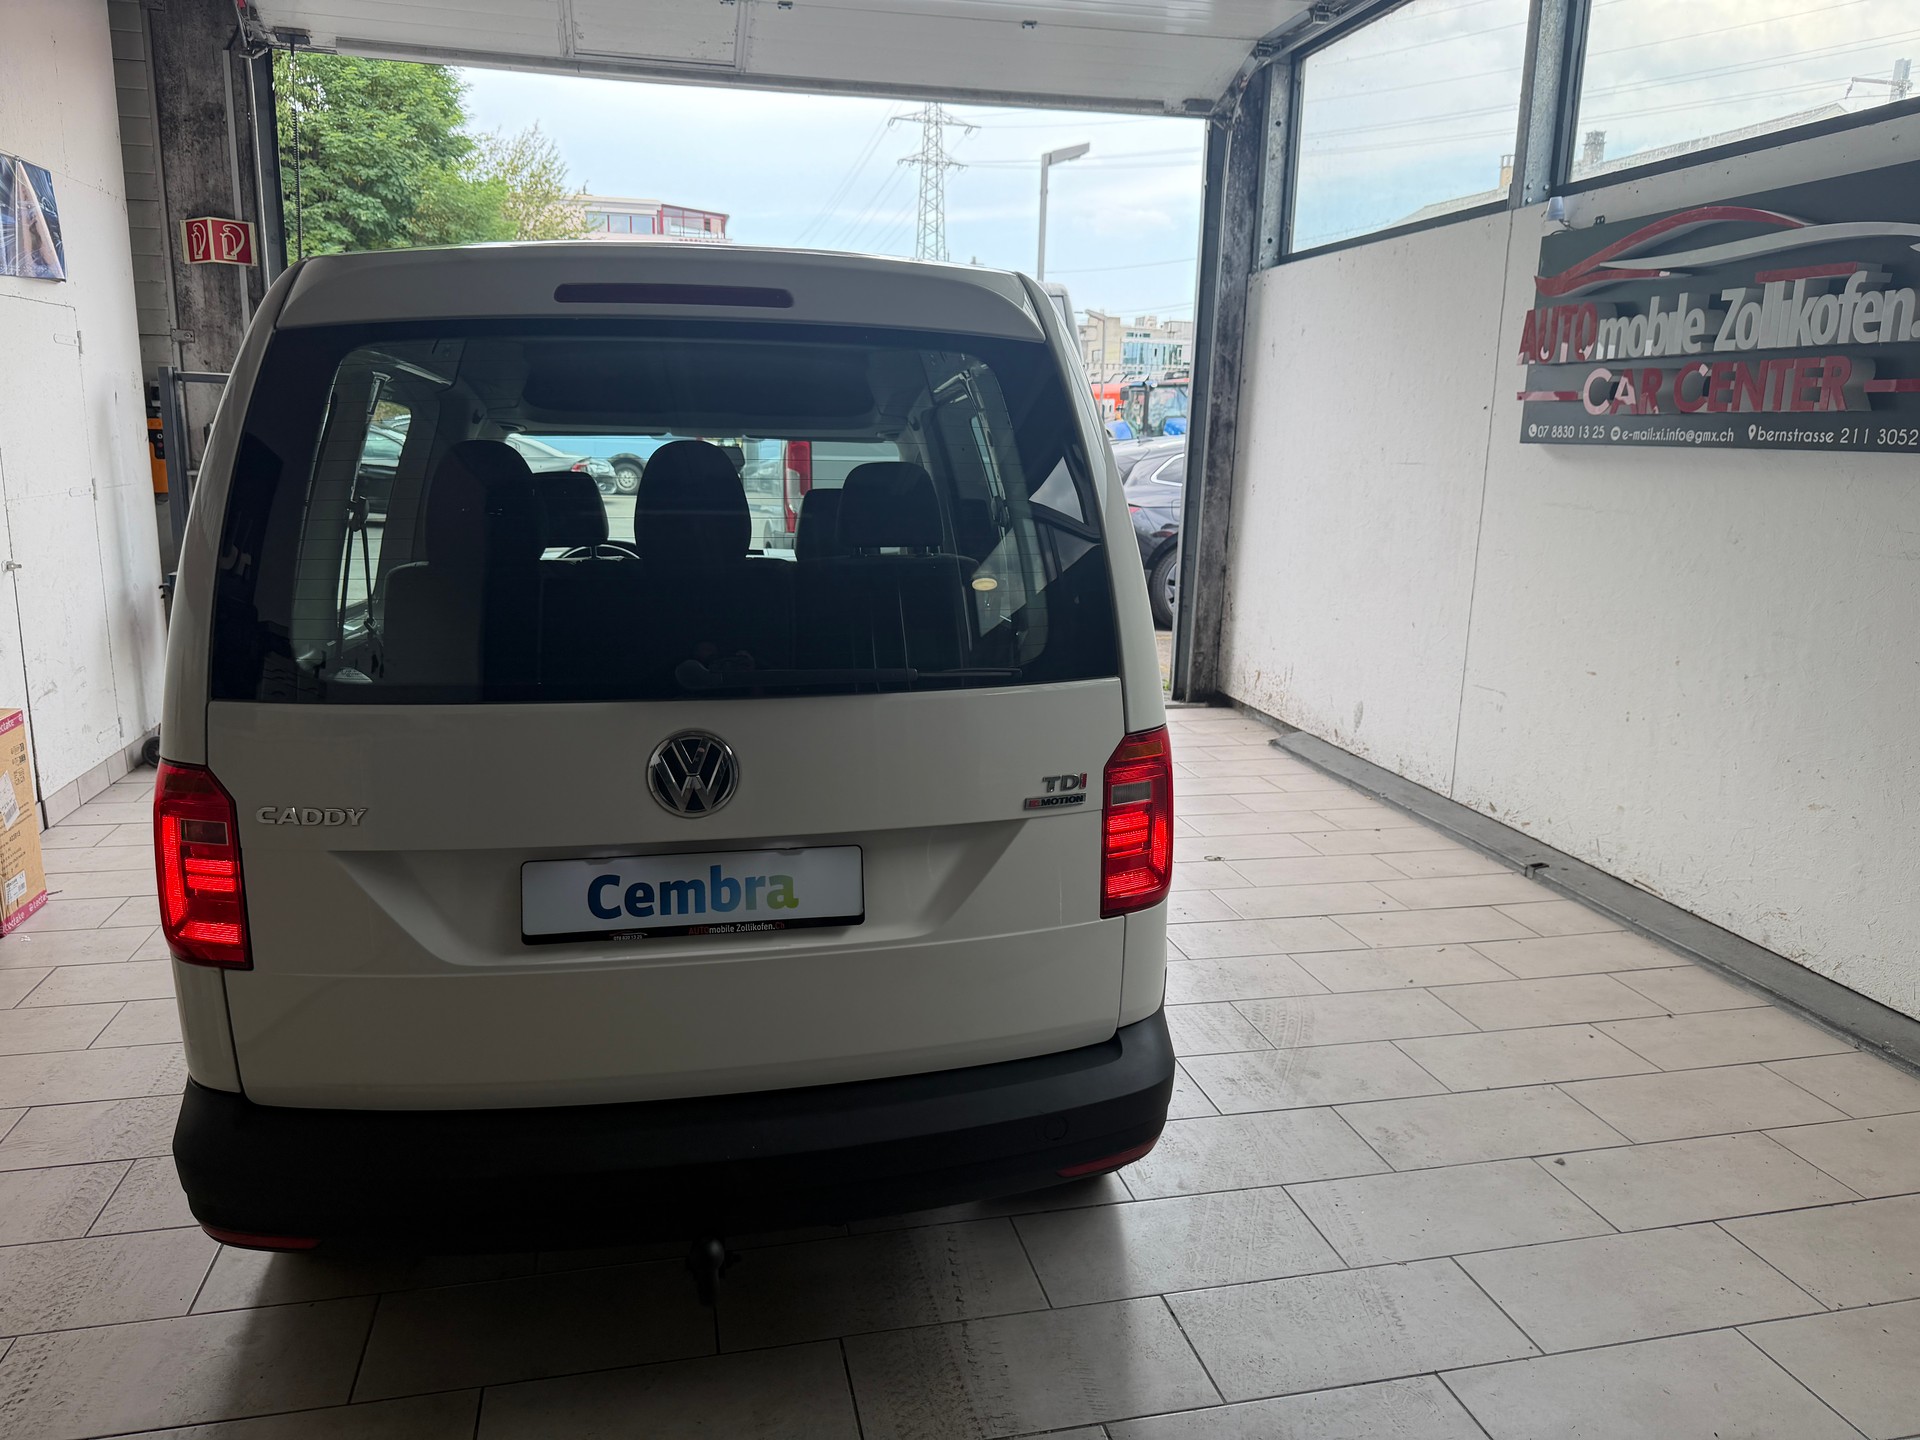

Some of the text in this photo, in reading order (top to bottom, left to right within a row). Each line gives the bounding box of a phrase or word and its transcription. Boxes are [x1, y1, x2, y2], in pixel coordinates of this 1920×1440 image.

[1517, 293, 1706, 365] AUTOmobile
[1583, 355, 1853, 415] CAR CENTER
[1537, 425, 1606, 439] 07 8830 13 25
[1757, 426, 1834, 443] bernstrasse
[1876, 428, 1920, 446] 3052
[1042, 772, 1088, 793] TDI
[255, 806, 368, 826] CADDY
[587, 864, 799, 920] Cembra
